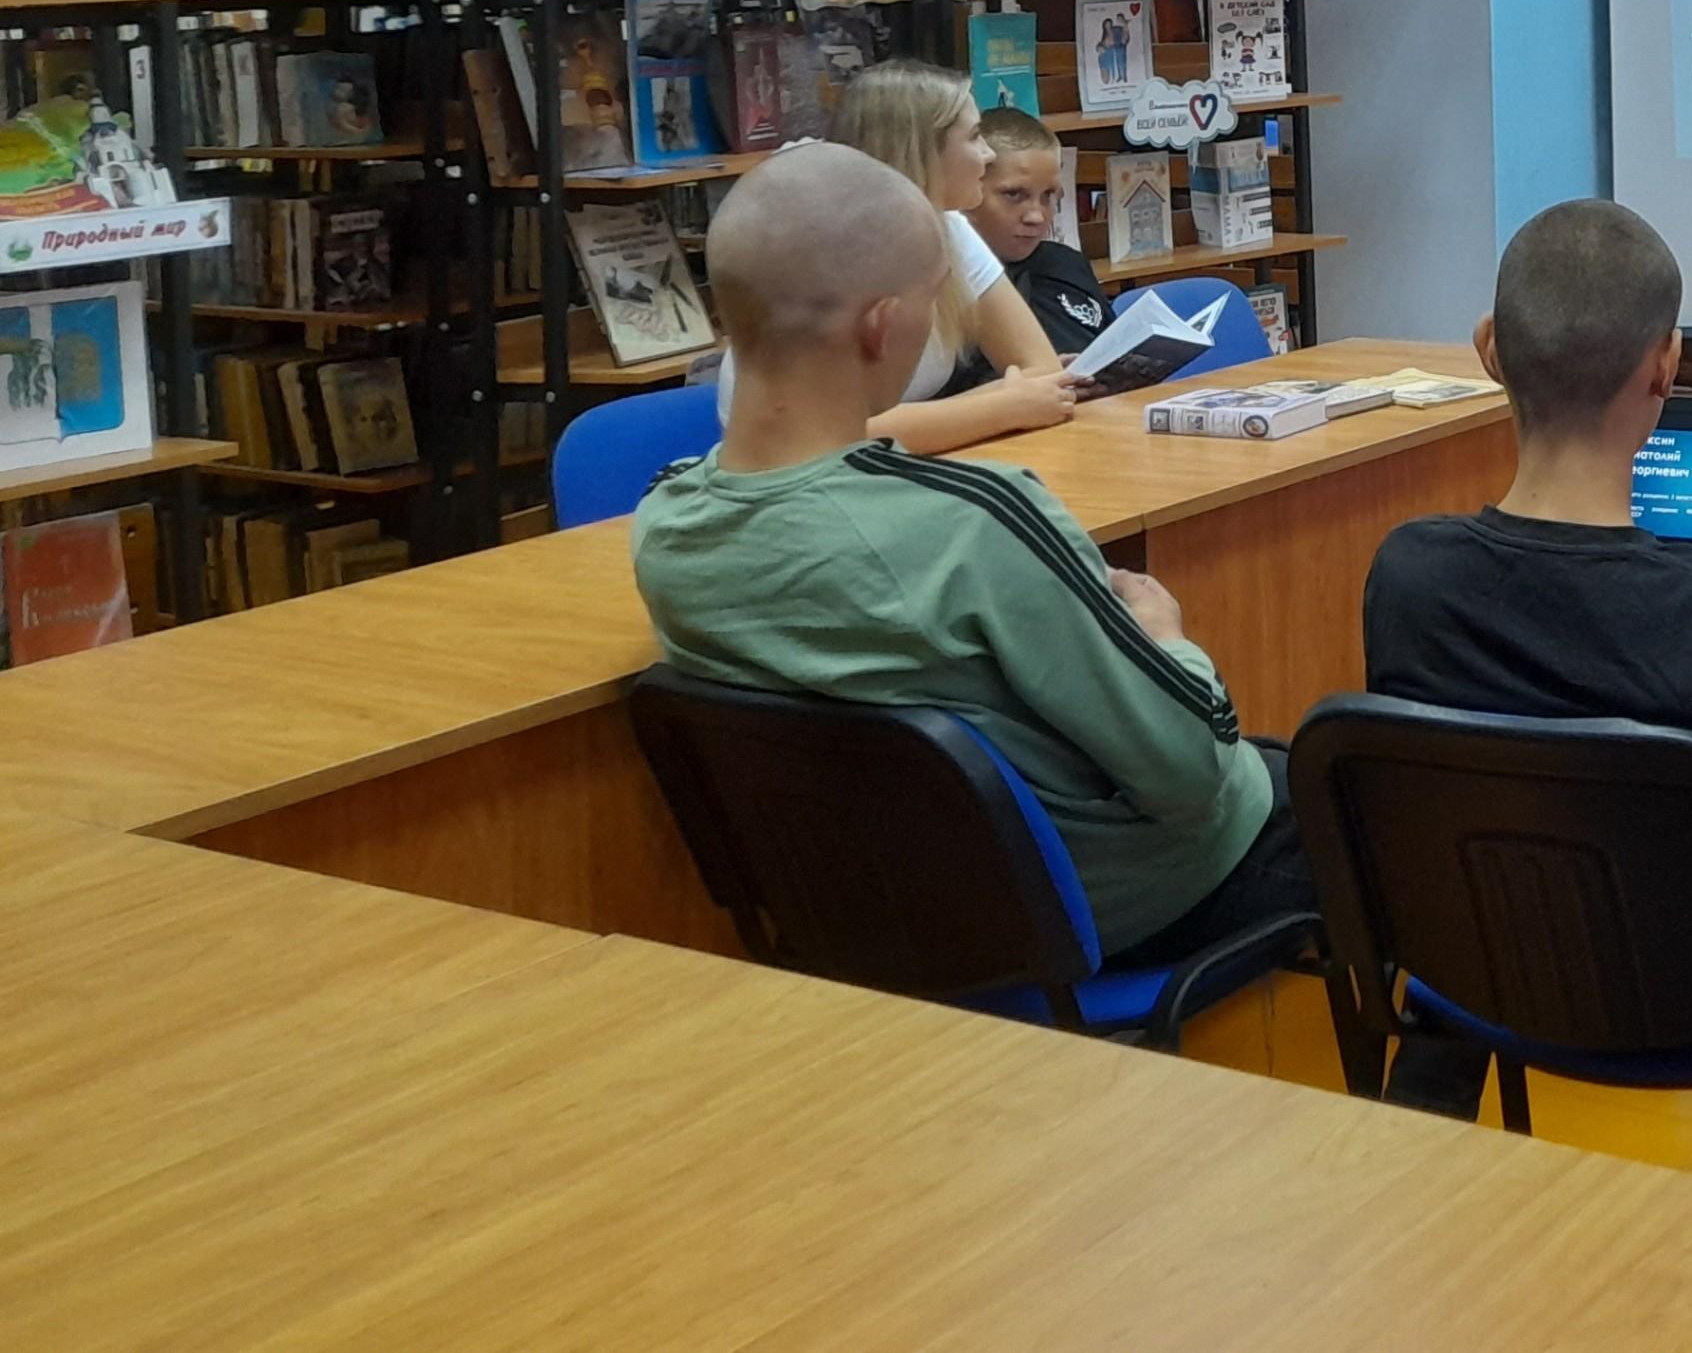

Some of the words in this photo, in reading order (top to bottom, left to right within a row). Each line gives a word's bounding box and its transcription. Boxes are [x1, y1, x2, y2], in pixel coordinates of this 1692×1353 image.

[42, 219, 146, 252] Природный
[151, 218, 187, 238] мир
[1647, 436, 1675, 446] ксин
